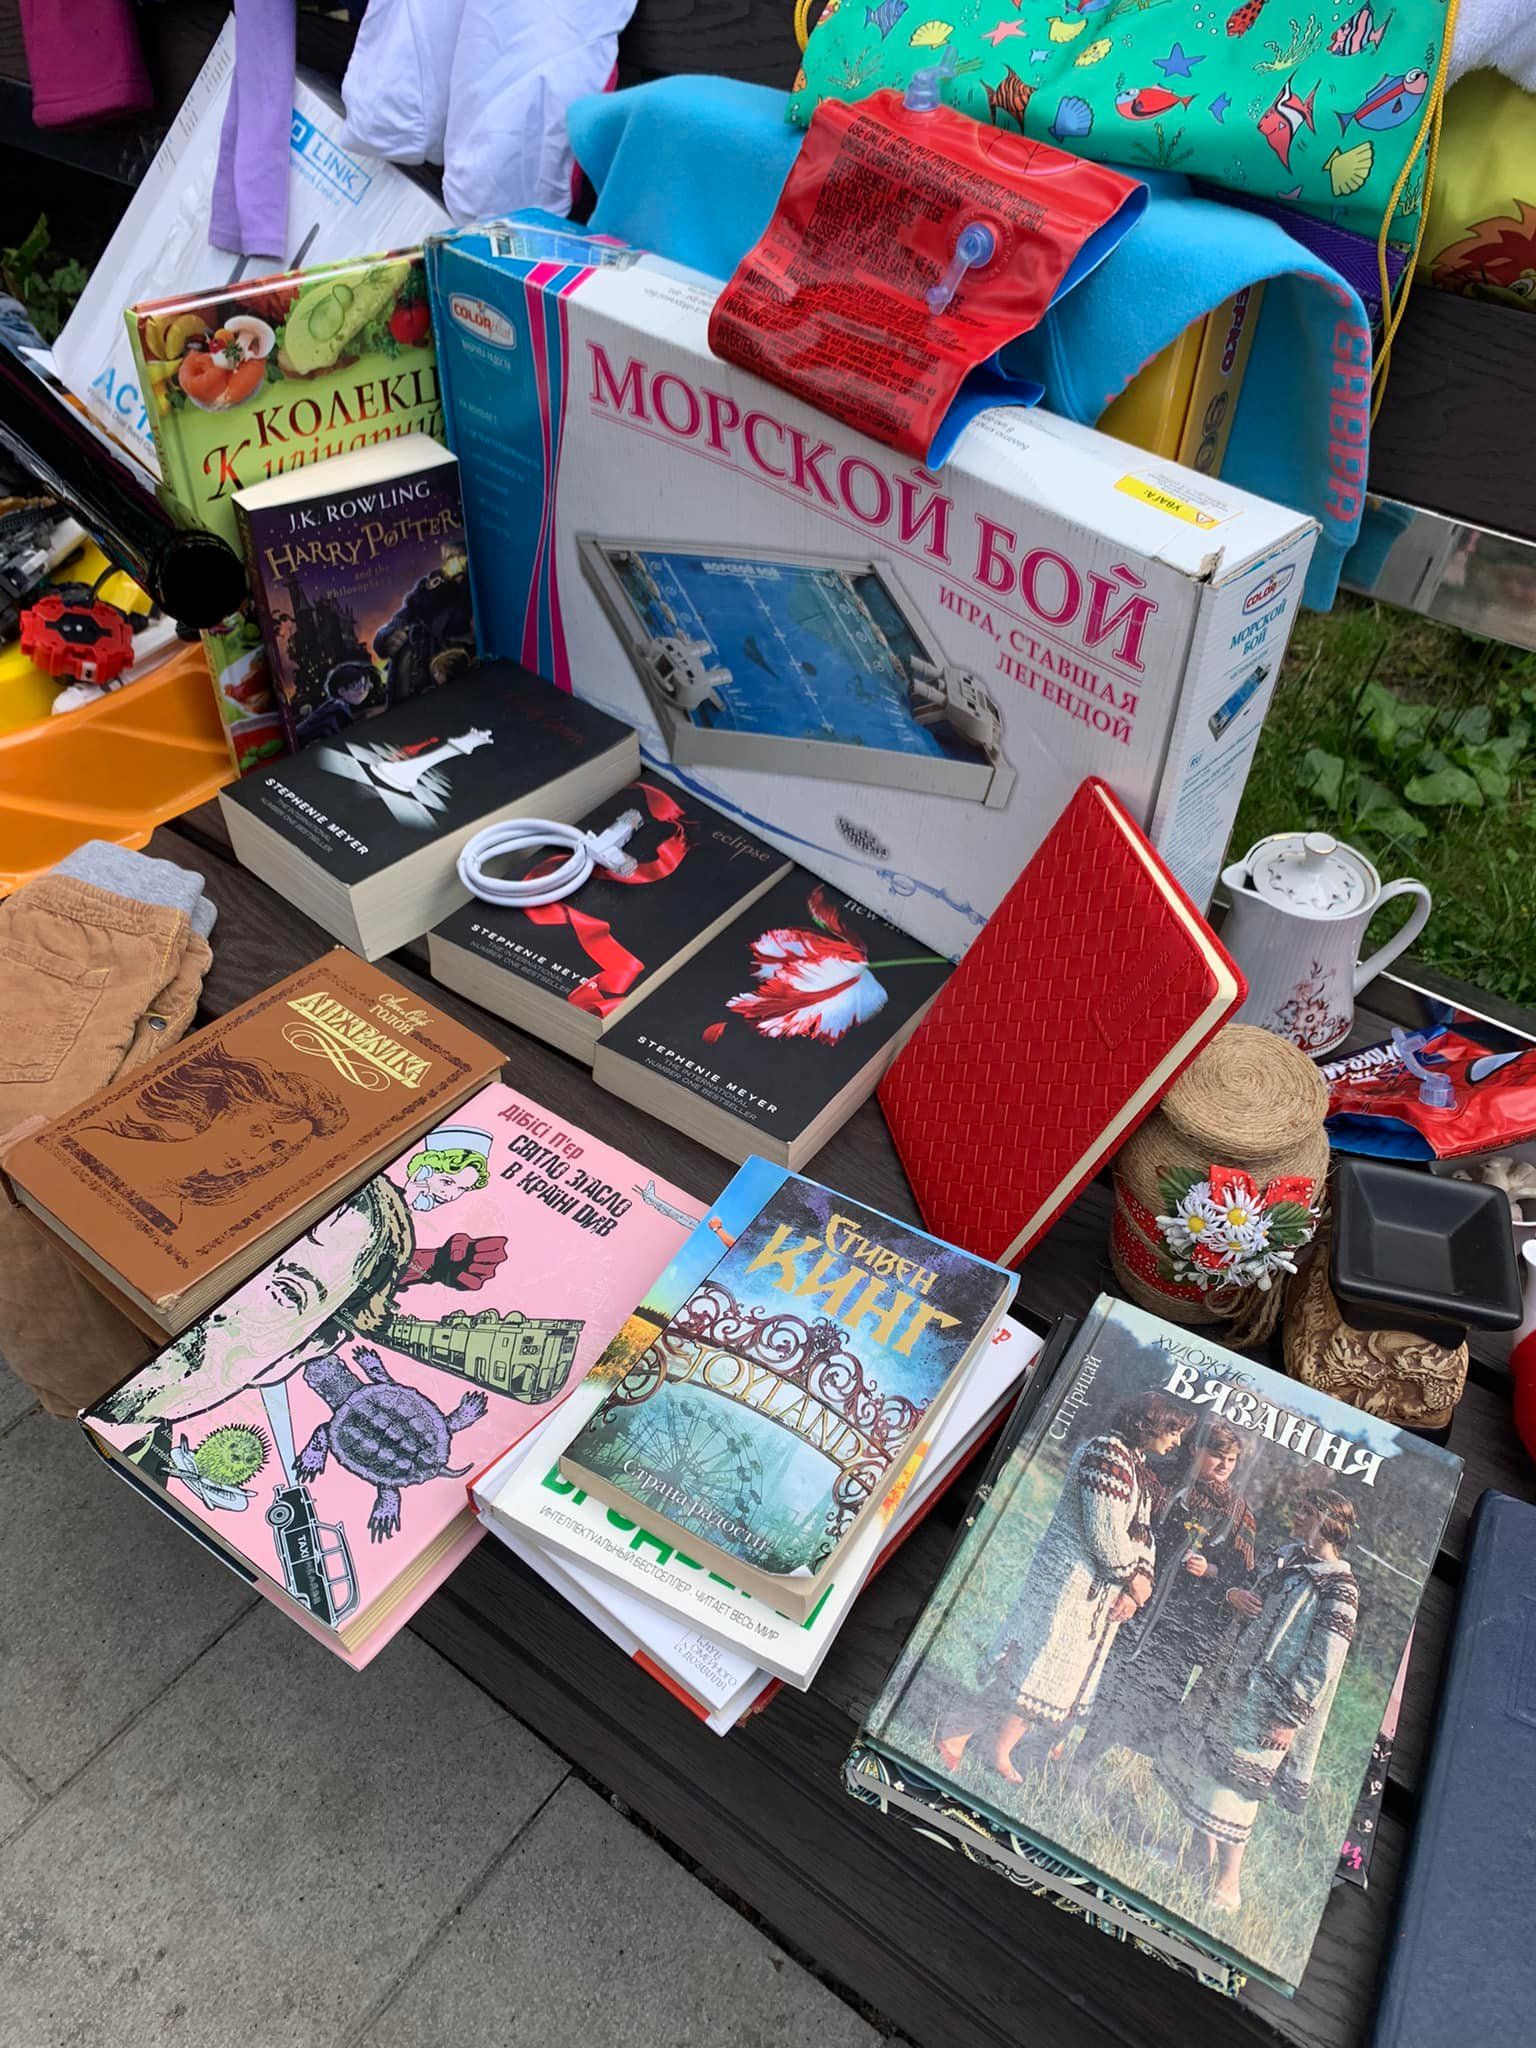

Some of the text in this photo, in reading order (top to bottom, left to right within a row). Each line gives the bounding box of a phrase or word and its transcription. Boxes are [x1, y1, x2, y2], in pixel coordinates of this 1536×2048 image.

[846, 121, 865, 138] USE
[1325, 320, 1371, 522] GABBA
[288, 480, 430, 534] J.K. ROWLING
[586, 339, 953, 565] МОРСКОЙ
[972, 512, 1159, 673] БОЙ
[264, 508, 462, 582] HARRY POTTER
[938, 584, 1002, 643] ИГРА,
[1008, 629, 1139, 718] СТАВШАЯ
[1229, 598, 1288, 650] МОРСКОЙ
[995, 652, 1133, 746] ЛЕГЕНДОЙ
[264, 778, 369, 855] STEPHENIE MEYER
[711, 830, 771, 862] eclipse
[843, 899, 879, 922] new
[471, 924, 598, 990] STEPHENIE MEYER
[287, 991, 432, 1088] АНЖЕЛИКА
[369, 1004, 415, 1036] ГОЛОН
[636, 1035, 778, 1114] STEPHENIE MEYER
[644, 1057, 758, 1121] NUMBER ONE BESTSELLER
[663, 1058, 749, 1108] THE INTERNATIONAL
[499, 1160, 523, 1180] В
[516, 1171, 581, 1215] КРАЇНІ
[507, 1134, 570, 1180] СВІТЛО
[744, 1223, 963, 1358] КИНГ
[825, 1213, 940, 1296] СТИВЕН
[673, 1342, 864, 1464] JOYLAND
[1049, 1354, 1102, 1441] С.П.Грицай
[622, 1458, 688, 1507] Страна
[687, 1499, 771, 1551] радости
[297, 1534, 309, 1558] TAXI
[539, 1505, 634, 1563] ИНТЕЛЛЕКТУАЛЬНЫЙ
[694, 1590, 731, 1616] ЧИТАЕТ
[729, 1608, 755, 1630] ВЕСЬ
[753, 1621, 780, 1641] МИР
